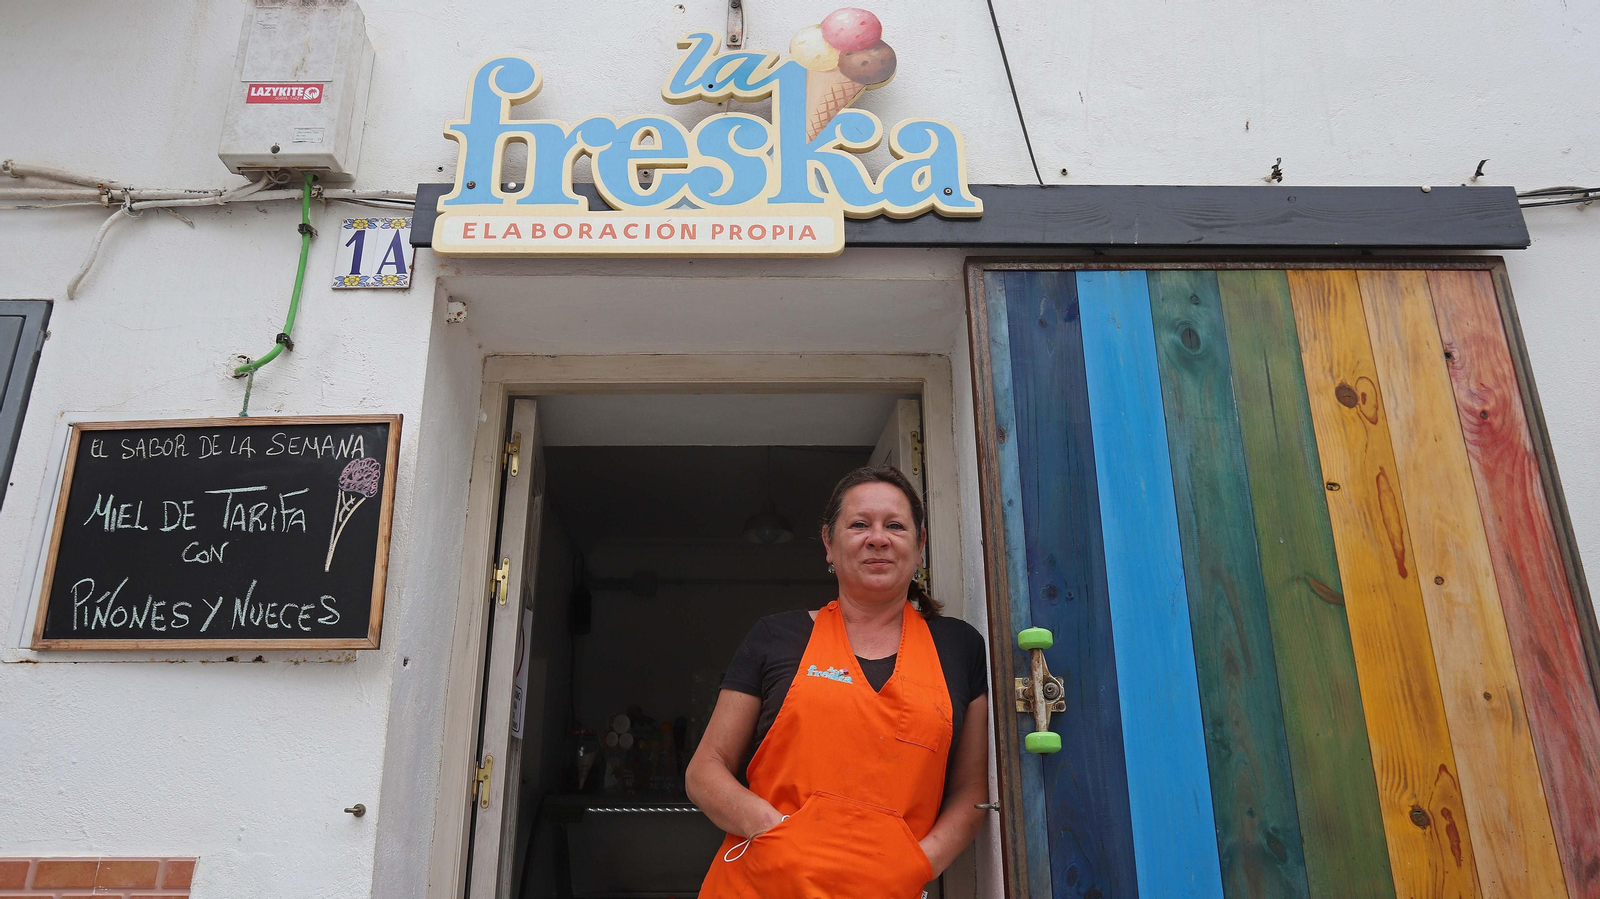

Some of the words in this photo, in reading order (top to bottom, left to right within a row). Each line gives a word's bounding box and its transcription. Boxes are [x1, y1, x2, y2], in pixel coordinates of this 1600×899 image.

[669, 31, 782, 94] la
[250, 86, 304, 97] LAZYKITE
[437, 56, 974, 210] freska
[464, 223, 695, 239] ELABORACIÓN
[712, 224, 815, 240] PROPIA
[91, 439, 108, 457] EL
[121, 434, 189, 459] SABOR
[199, 435, 222, 459] DE
[230, 436, 256, 458] LA
[266, 433, 366, 462] SEMANA
[84, 494, 148, 531] MIEL
[160, 500, 196, 531] DE
[205, 486, 309, 532] TARIFA
[182, 542, 229, 563] CON
[71, 577, 191, 631] PIÑONES
[200, 597, 223, 632] Y
[232, 580, 340, 631] NUECES
